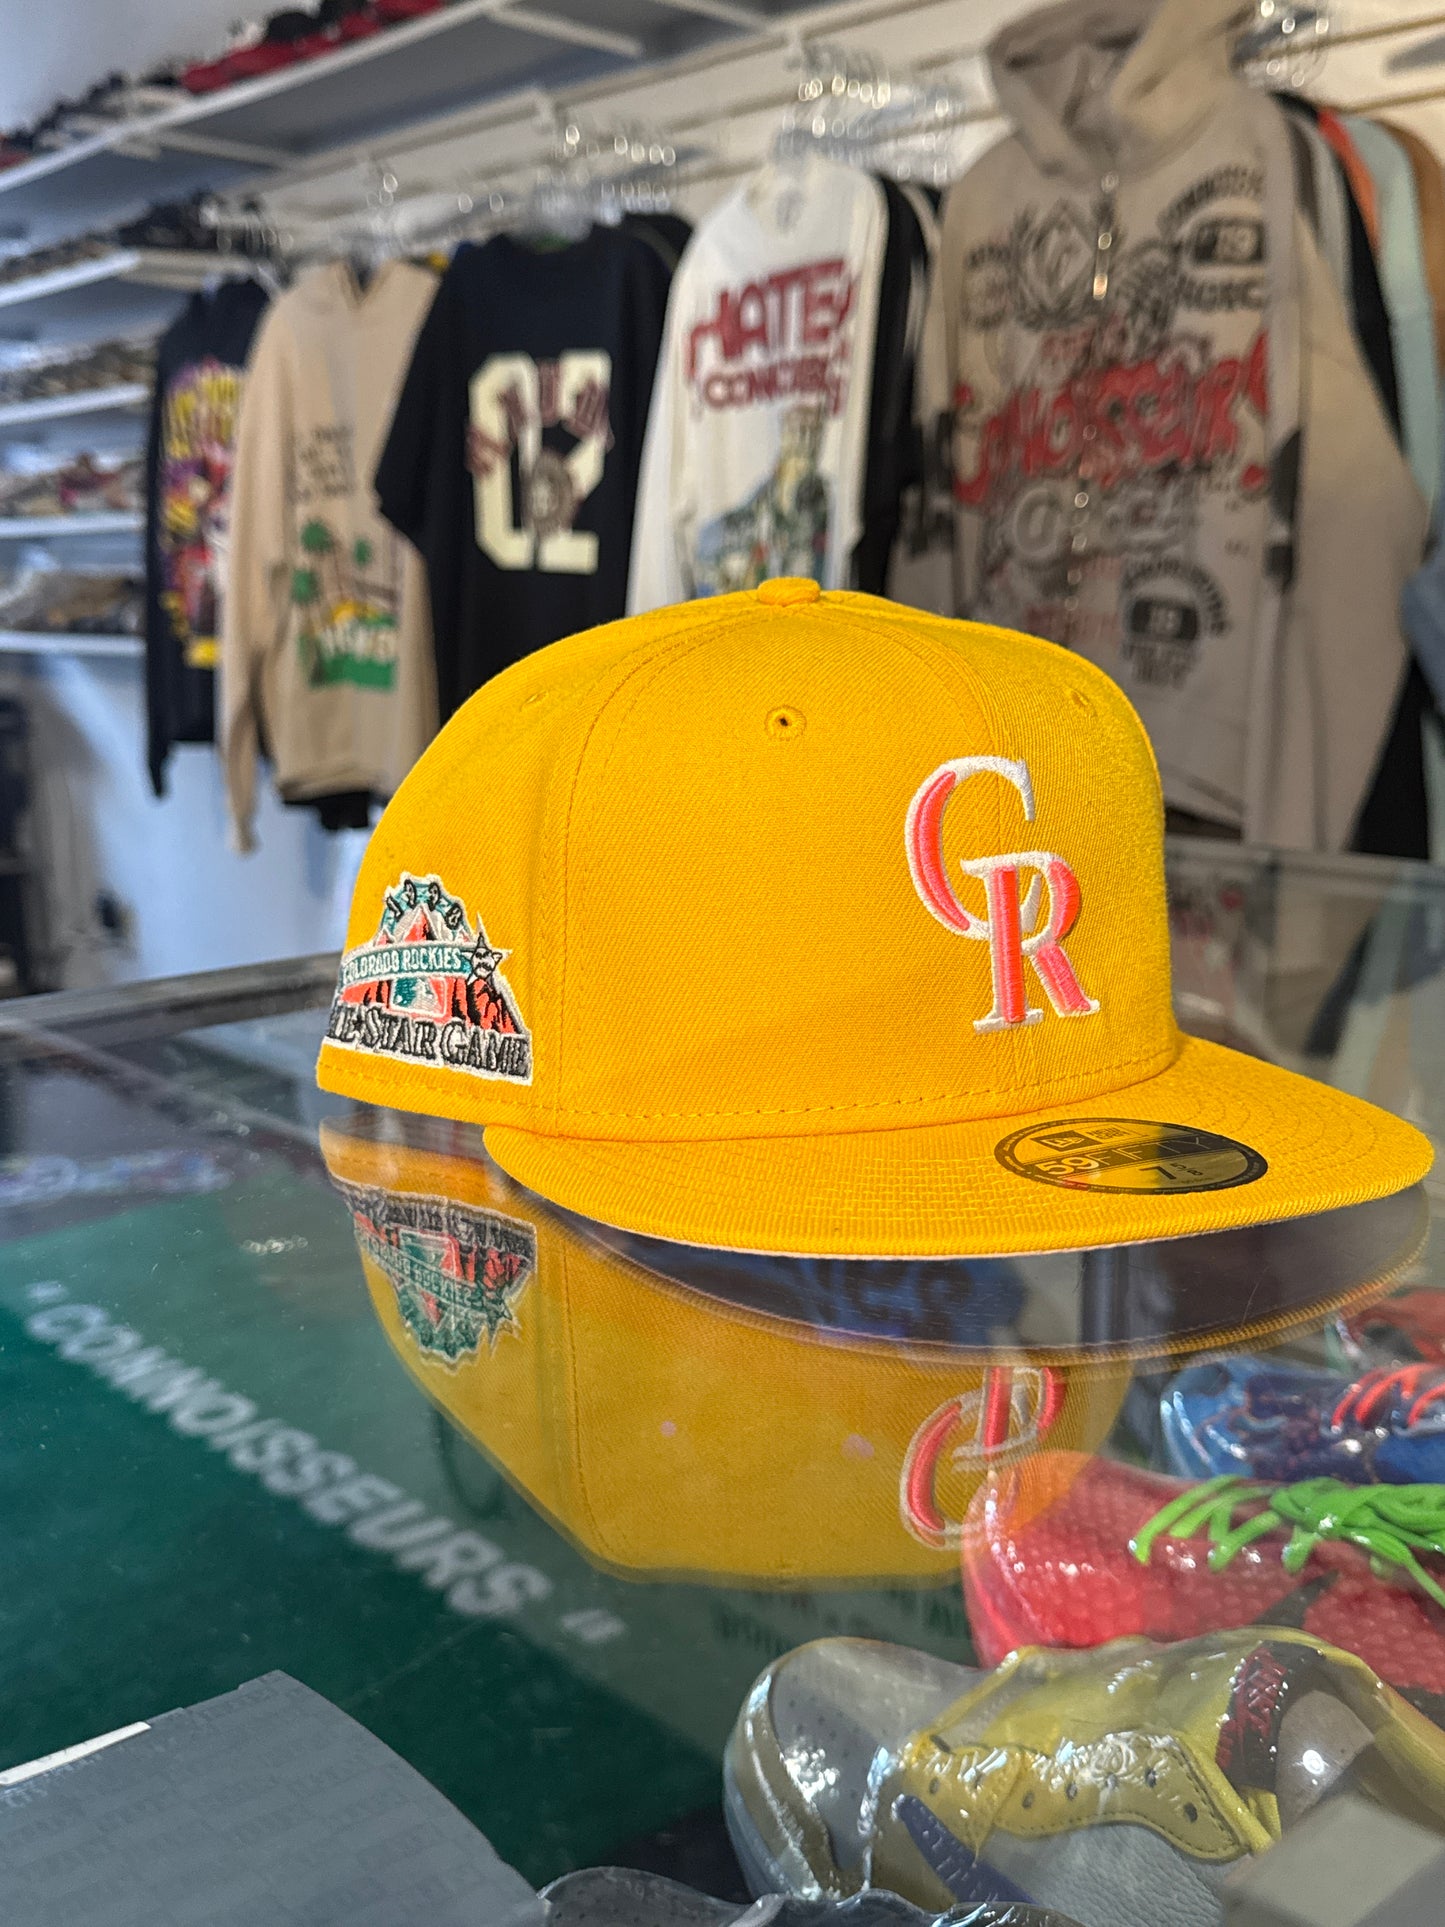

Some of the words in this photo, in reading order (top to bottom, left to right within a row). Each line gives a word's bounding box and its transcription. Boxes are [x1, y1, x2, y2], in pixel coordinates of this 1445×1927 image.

[904, 755, 1101, 1034] CR
[402, 947, 462, 970] ROCKIES
[440, 1021, 528, 1077] GAME
